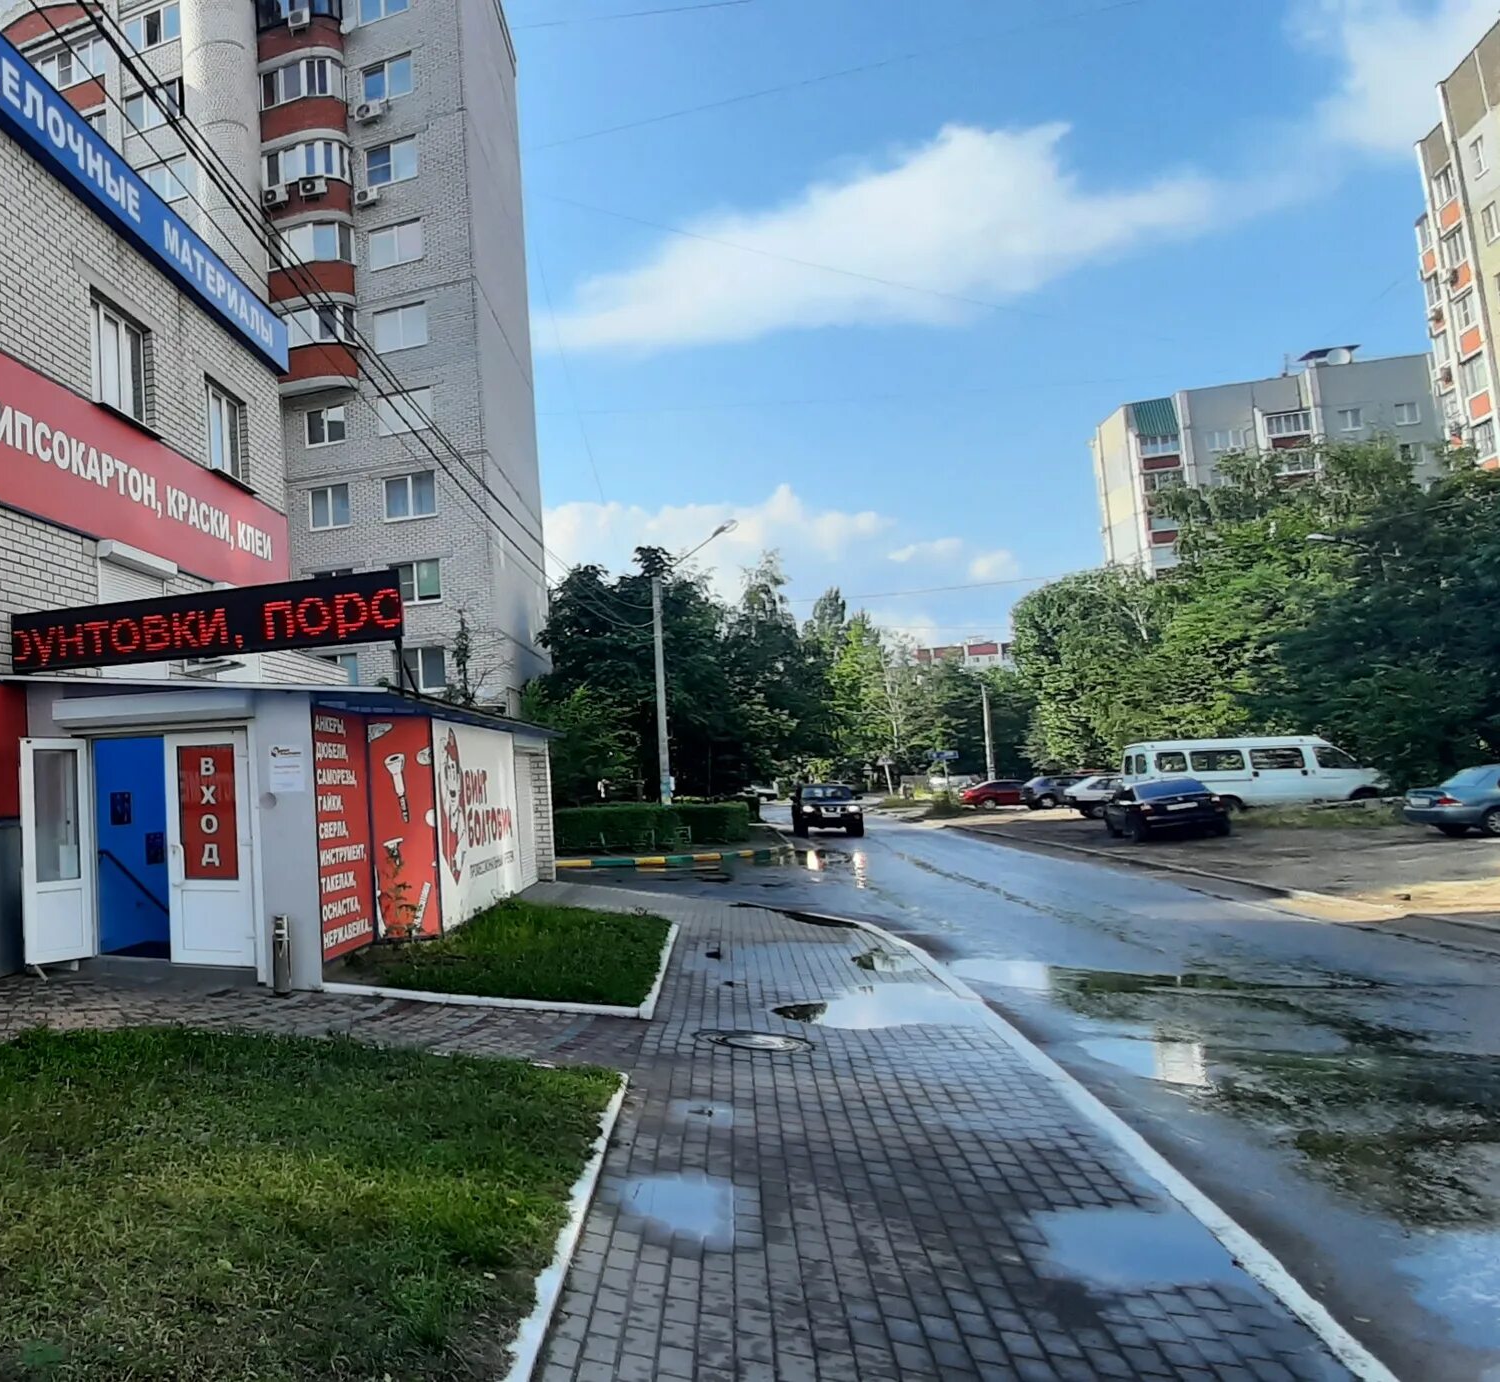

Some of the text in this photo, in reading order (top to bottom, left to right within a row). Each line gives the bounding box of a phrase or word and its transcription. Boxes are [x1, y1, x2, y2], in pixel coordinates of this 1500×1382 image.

[163, 219, 274, 348] МАТЕРИАЛЫ
[165, 485, 236, 552] КРАСКИ,
[237, 519, 274, 562] КЛЕИ
[314, 714, 347, 738] АНКЕРЫ,
[315, 741, 349, 763] ДЮБЕЛИ,
[316, 768, 358, 788] САМОРЕЗЫ,
[464, 768, 487, 806] ВИНТ
[199, 756, 221, 868] ВХОД
[317, 792, 344, 814] ГАЙКИ,
[318, 820, 349, 840] СВЕРЛА,
[319, 843, 367, 868] ИНСТРУМЕНТ,
[322, 895, 361, 923] ОСНАСТКА,
